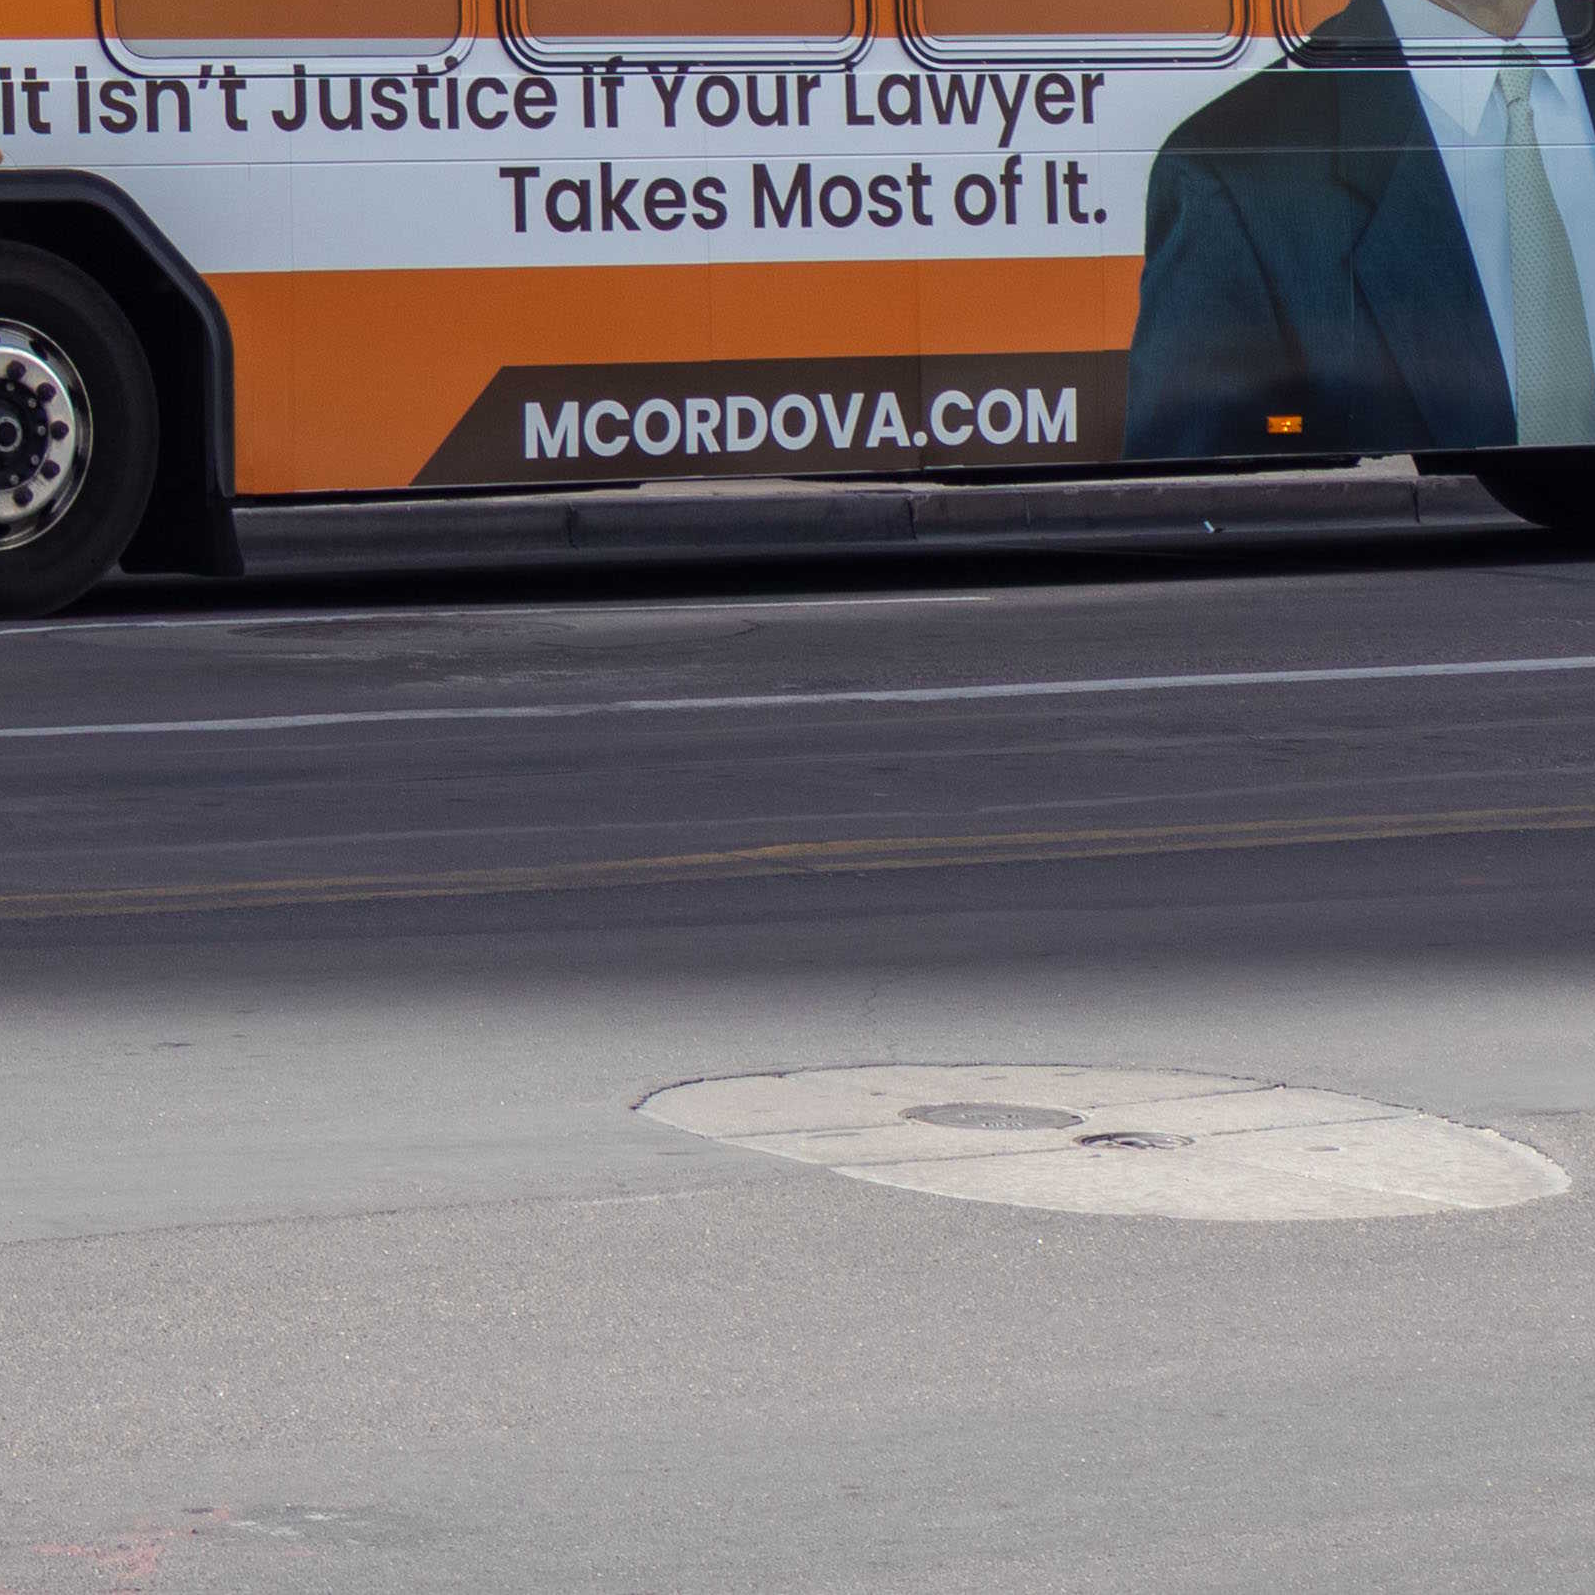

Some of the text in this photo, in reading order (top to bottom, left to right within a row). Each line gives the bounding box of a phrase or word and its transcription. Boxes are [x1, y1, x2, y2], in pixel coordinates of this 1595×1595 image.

[271, 55, 559, 133] Justice
[646, 64, 822, 129] Your
[843, 60, 1106, 149] Lawyer
[499, 154, 1109, 234] Takes Most of It.
[523, 386, 1079, 459] MCORDOVA.COM
